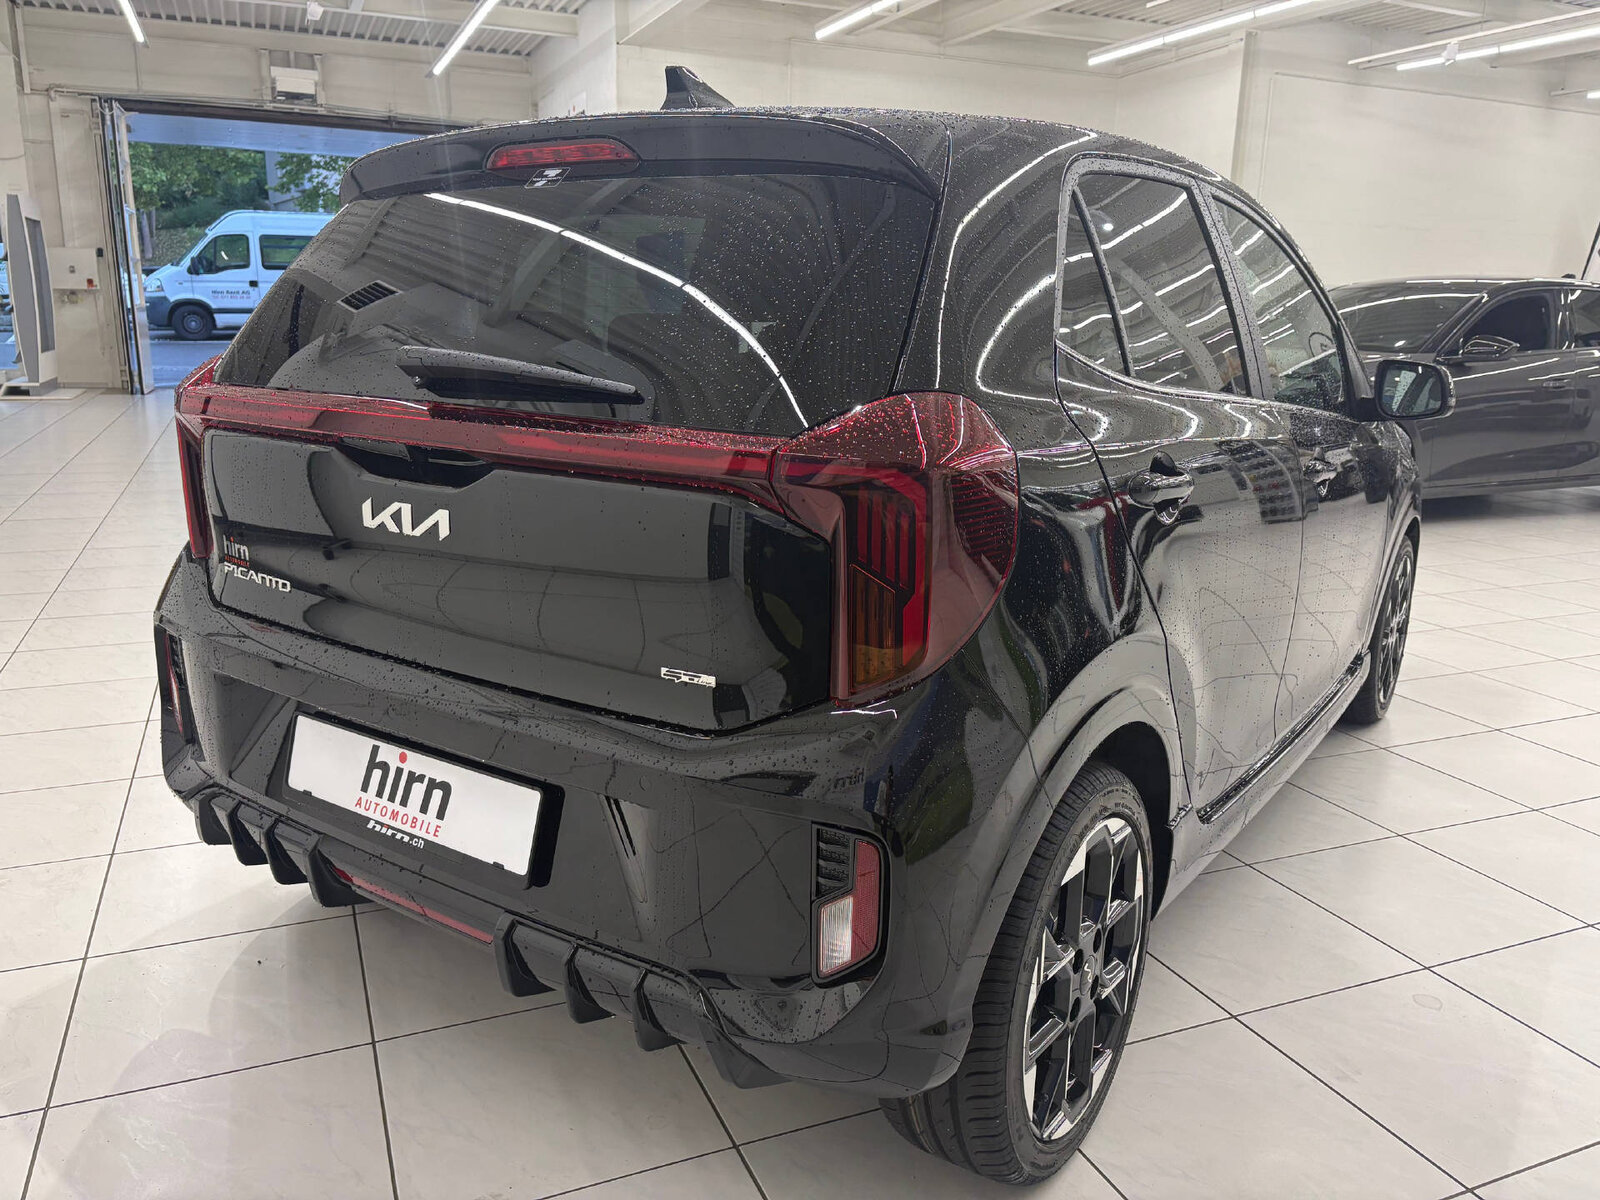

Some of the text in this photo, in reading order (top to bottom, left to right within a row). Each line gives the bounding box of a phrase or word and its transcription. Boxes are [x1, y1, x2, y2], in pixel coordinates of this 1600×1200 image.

[362, 497, 450, 541] KIA
[223, 534, 249, 561] hirn
[224, 562, 291, 593] PICANTO
[360, 744, 452, 821] hirn
[355, 796, 441, 838] AUTOMOBILE
[366, 819, 425, 849] hirn.ch
